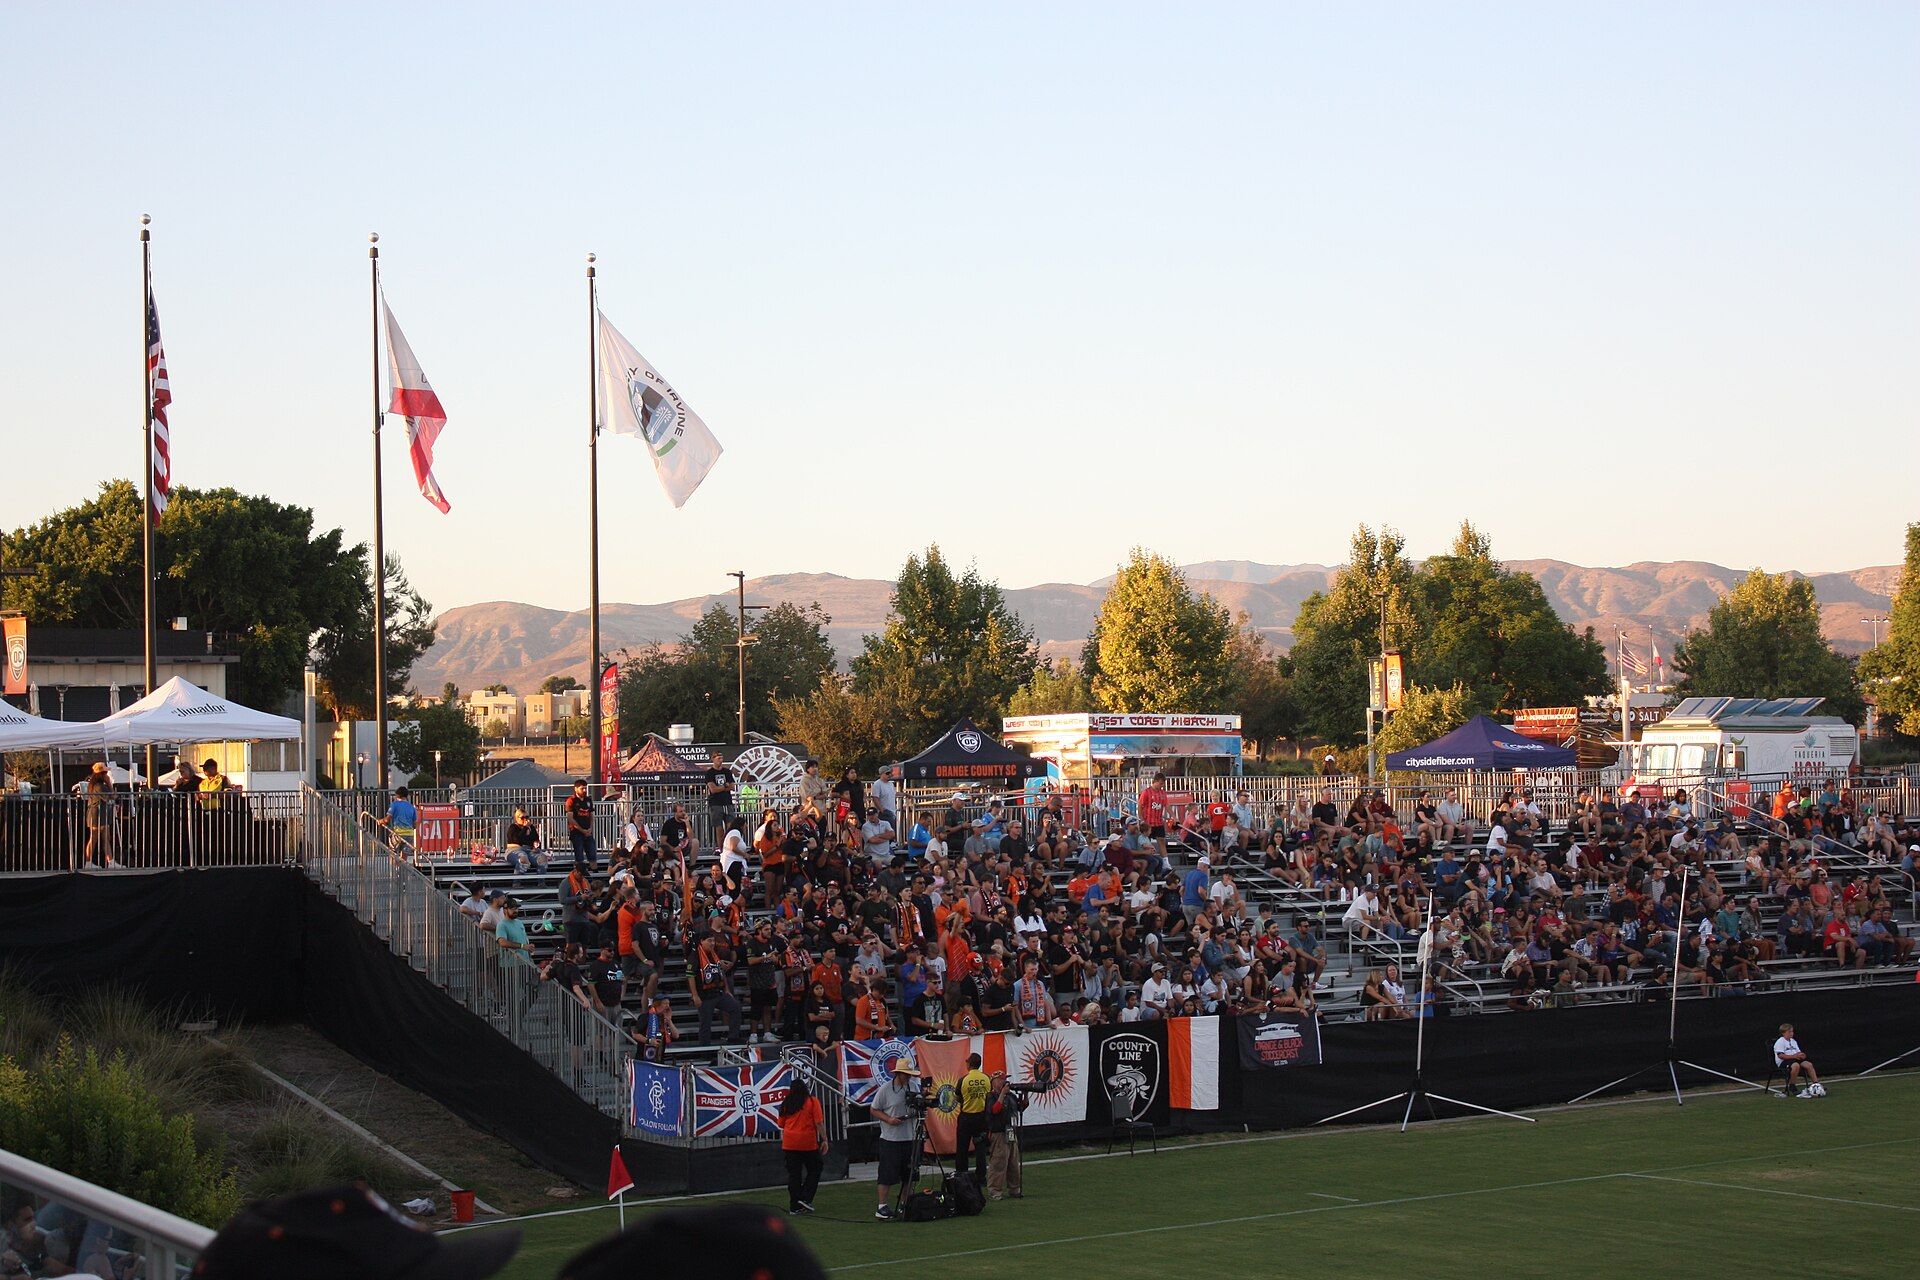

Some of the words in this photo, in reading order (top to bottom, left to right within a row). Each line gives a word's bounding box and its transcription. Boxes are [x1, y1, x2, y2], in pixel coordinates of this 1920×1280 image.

[644, 371, 665, 385] OF
[666, 388, 686, 437] IRVINE
[1129, 716, 1166, 726] COAST
[1171, 717, 1217, 726] HIBACHI
[1639, 711, 1660, 722] SALT
[1794, 750, 1825, 758] TAQUERIA
[1405, 756, 1475, 768] citysidefiber.com
[936, 765, 968, 777] ORANGE
[970, 764, 1003, 776] COUNTY
[1005, 764, 1017, 776] SC
[1109, 1041, 1151, 1053] COUNTY
[1284, 1038, 1303, 1049] BLACK
[874, 1043, 909, 1060] RANGERS
[1118, 1051, 1142, 1061] LINE
[701, 1097, 732, 1106] RANGERS
